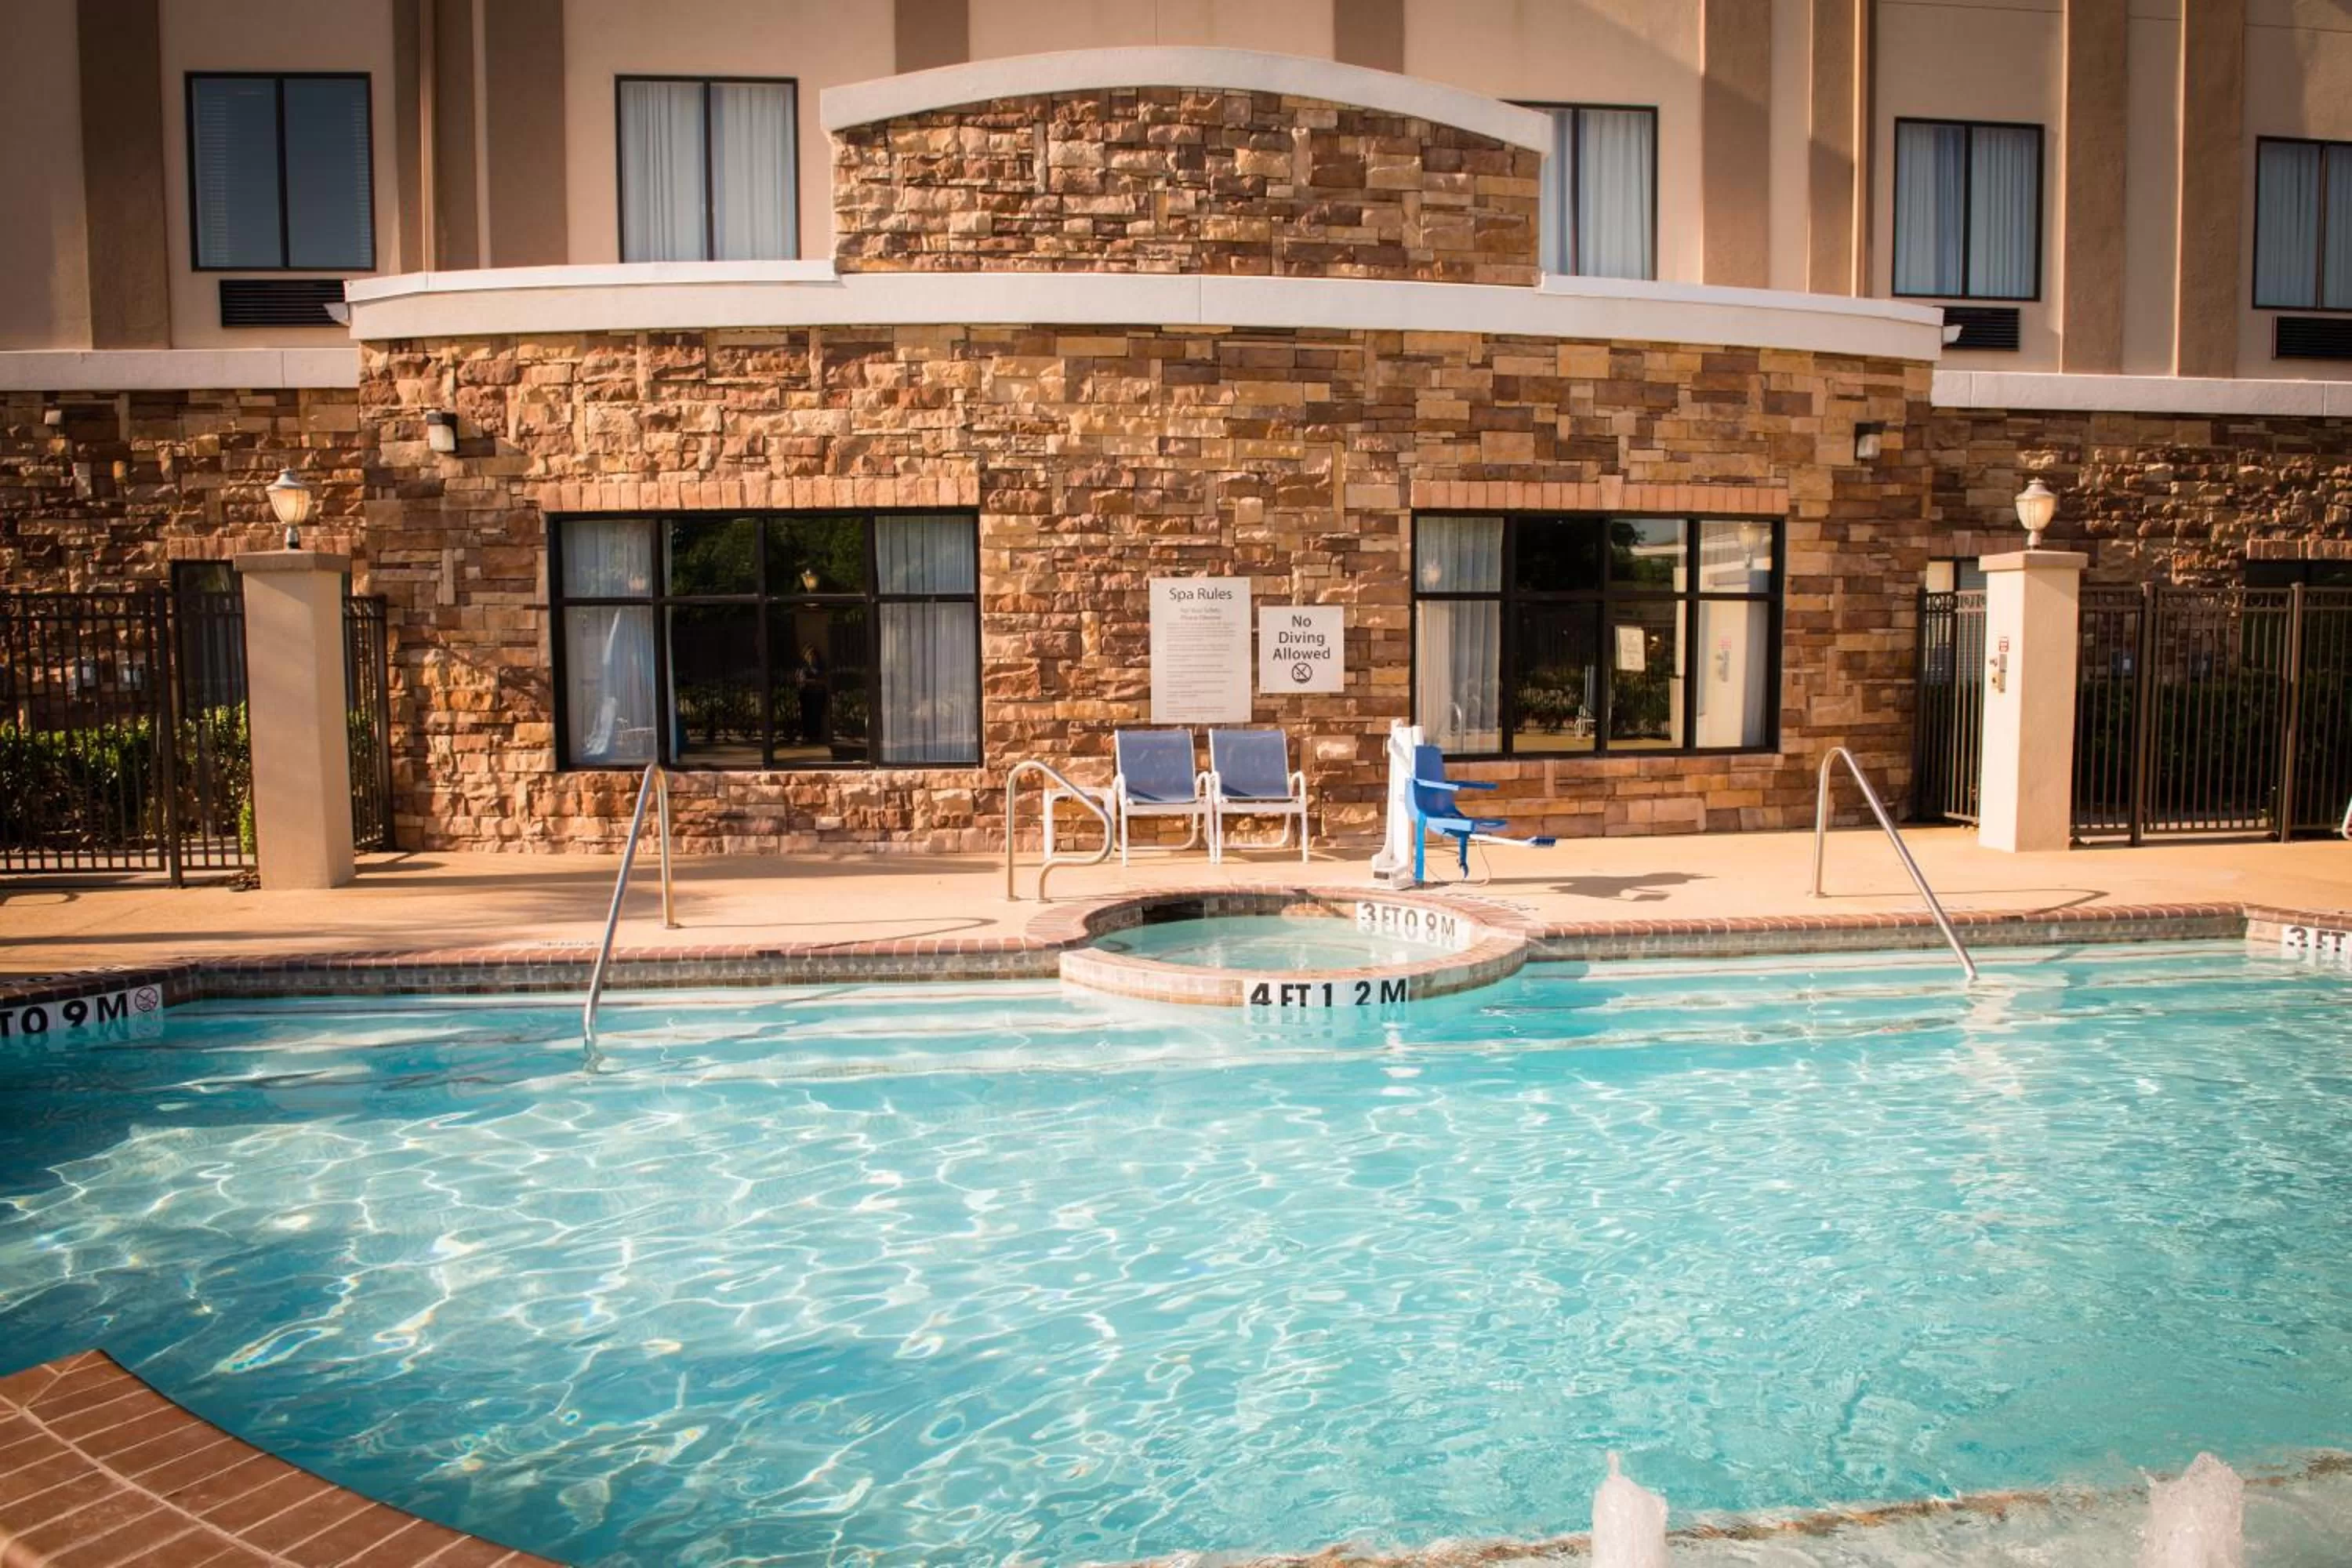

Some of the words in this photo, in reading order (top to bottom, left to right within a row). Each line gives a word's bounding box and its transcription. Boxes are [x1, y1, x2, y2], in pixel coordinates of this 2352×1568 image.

[1169, 587, 1194, 602] Spa
[1197, 587, 1232, 600] Rules
[1291, 615, 1312, 627] No
[1279, 631, 1325, 646] Diving
[1272, 648, 1330, 660] Allowed
[1250, 982, 1272, 1005] 4
[1281, 983, 1311, 1007] FT
